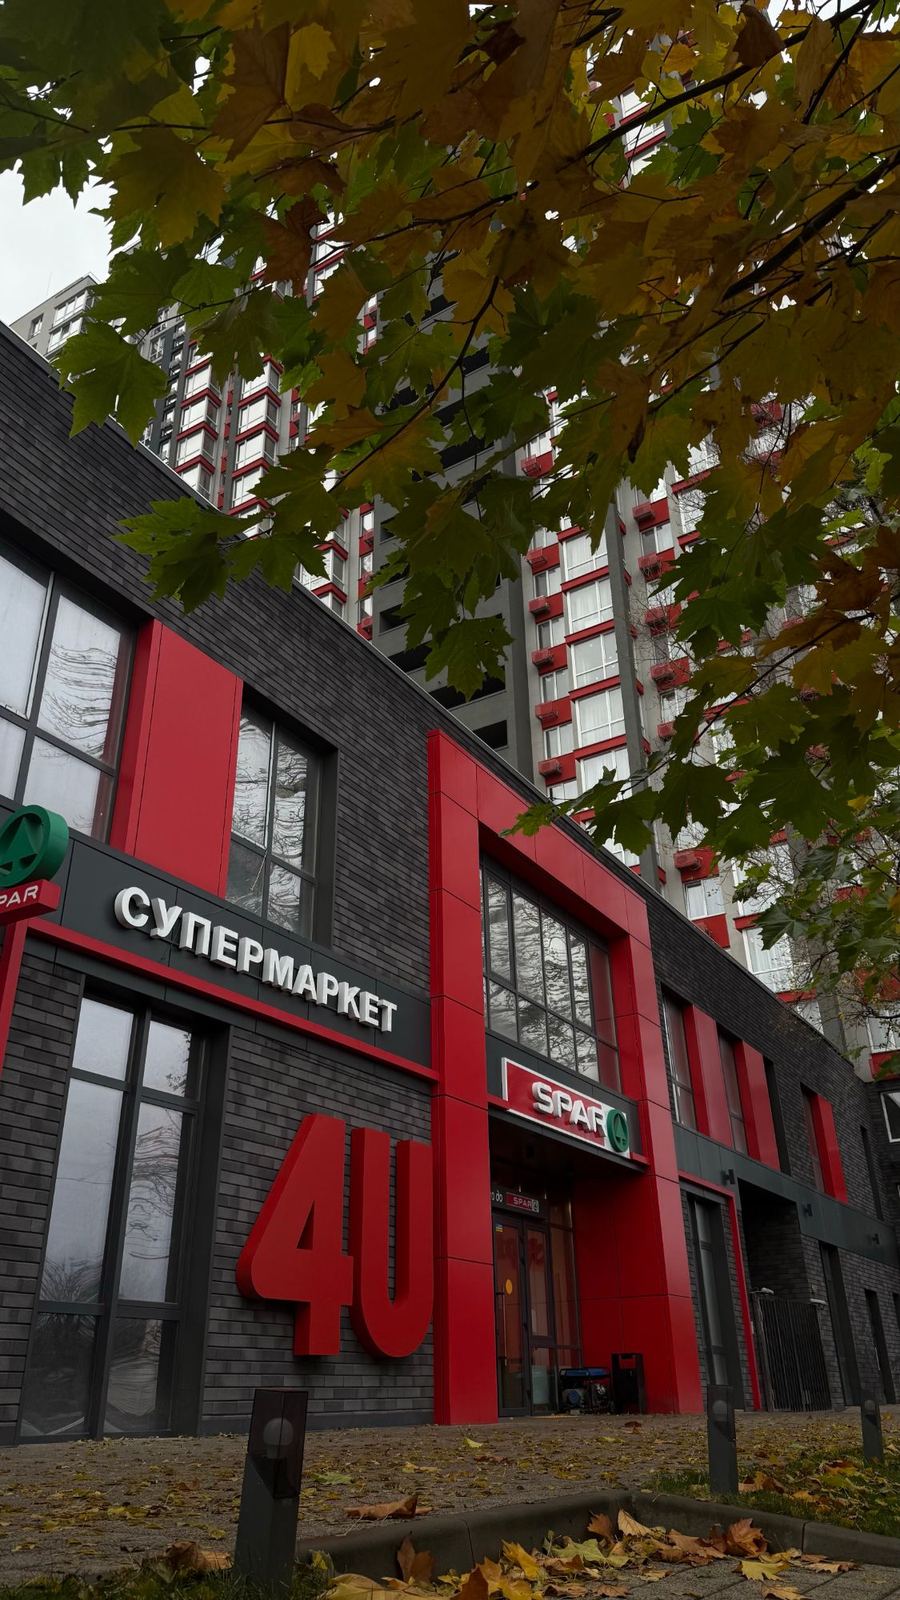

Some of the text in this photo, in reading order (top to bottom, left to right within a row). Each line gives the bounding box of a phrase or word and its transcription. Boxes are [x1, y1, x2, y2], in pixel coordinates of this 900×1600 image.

[0, 885, 39, 908] PAR
[114, 886, 397, 1033] СУПЕРМАРКЕТ
[532, 1081, 607, 1138] SPAR
[512, 1196, 532, 1209] SPAR
[235, 1112, 435, 1358] 4U
